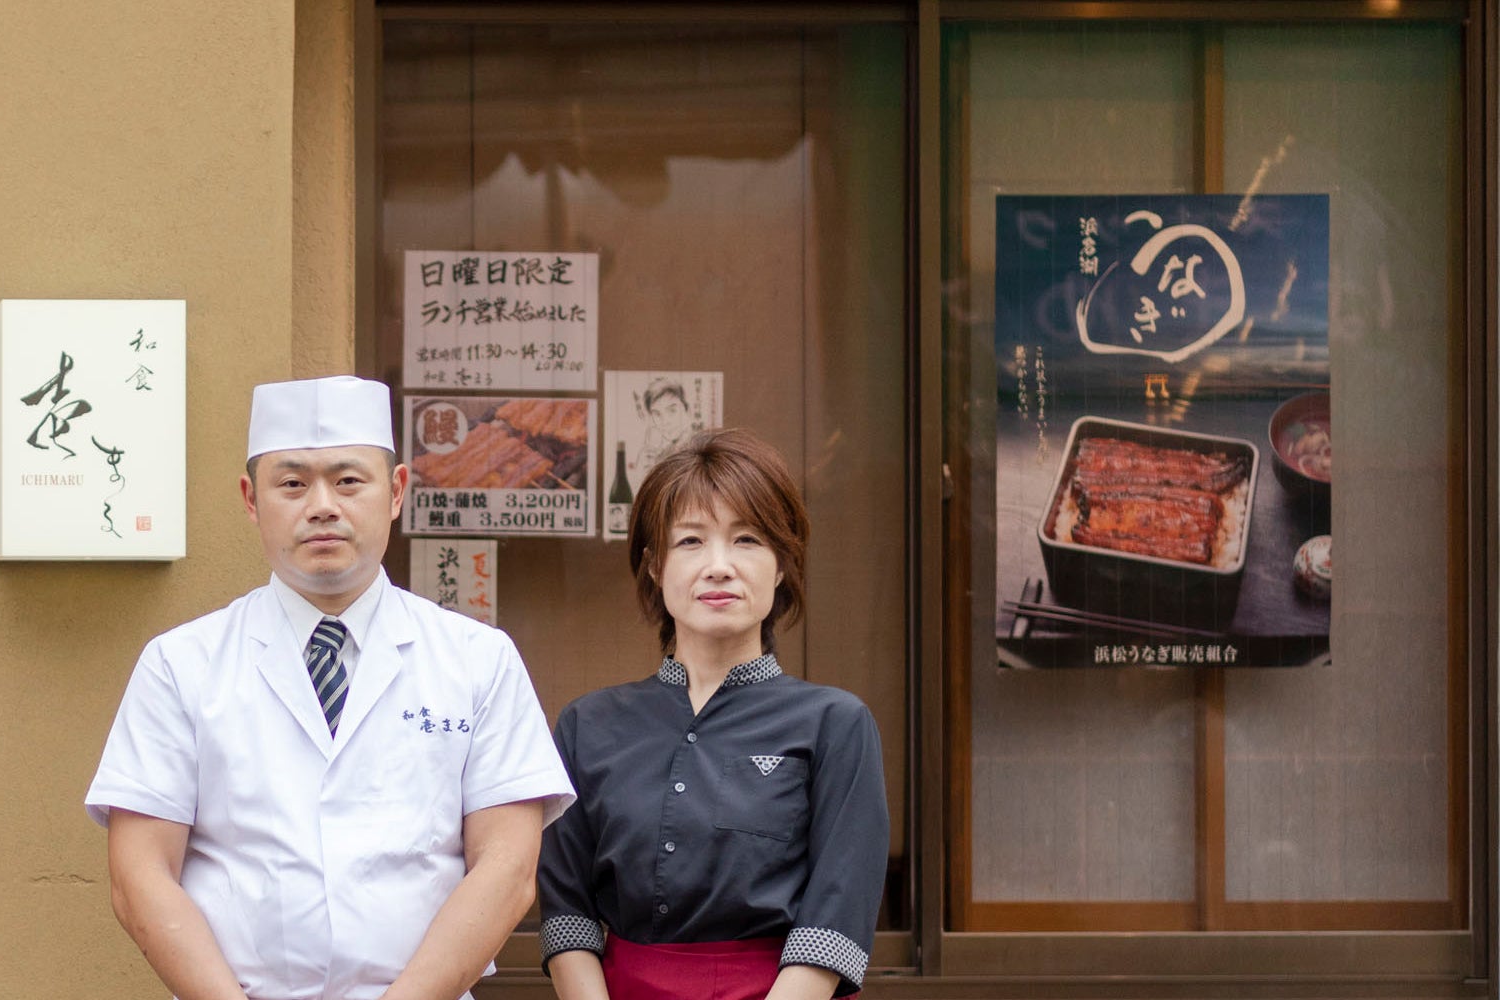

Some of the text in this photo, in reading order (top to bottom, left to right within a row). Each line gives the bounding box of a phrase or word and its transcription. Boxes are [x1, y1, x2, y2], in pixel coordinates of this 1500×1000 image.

[1079, 216, 1099, 277] 浜名湖
[420, 256, 574, 288] 日曜日限定
[420, 296, 587, 327] ランチ営業始めました
[125, 327, 157, 391] 和食
[422, 408, 460, 446] 鰻
[20, 473, 85, 487] ICHIMARU
[505, 492, 582, 510] 3,200円
[479, 511, 556, 528] 3,500円
[1094, 644, 1239, 664] 浜松うなぎ販売組合
